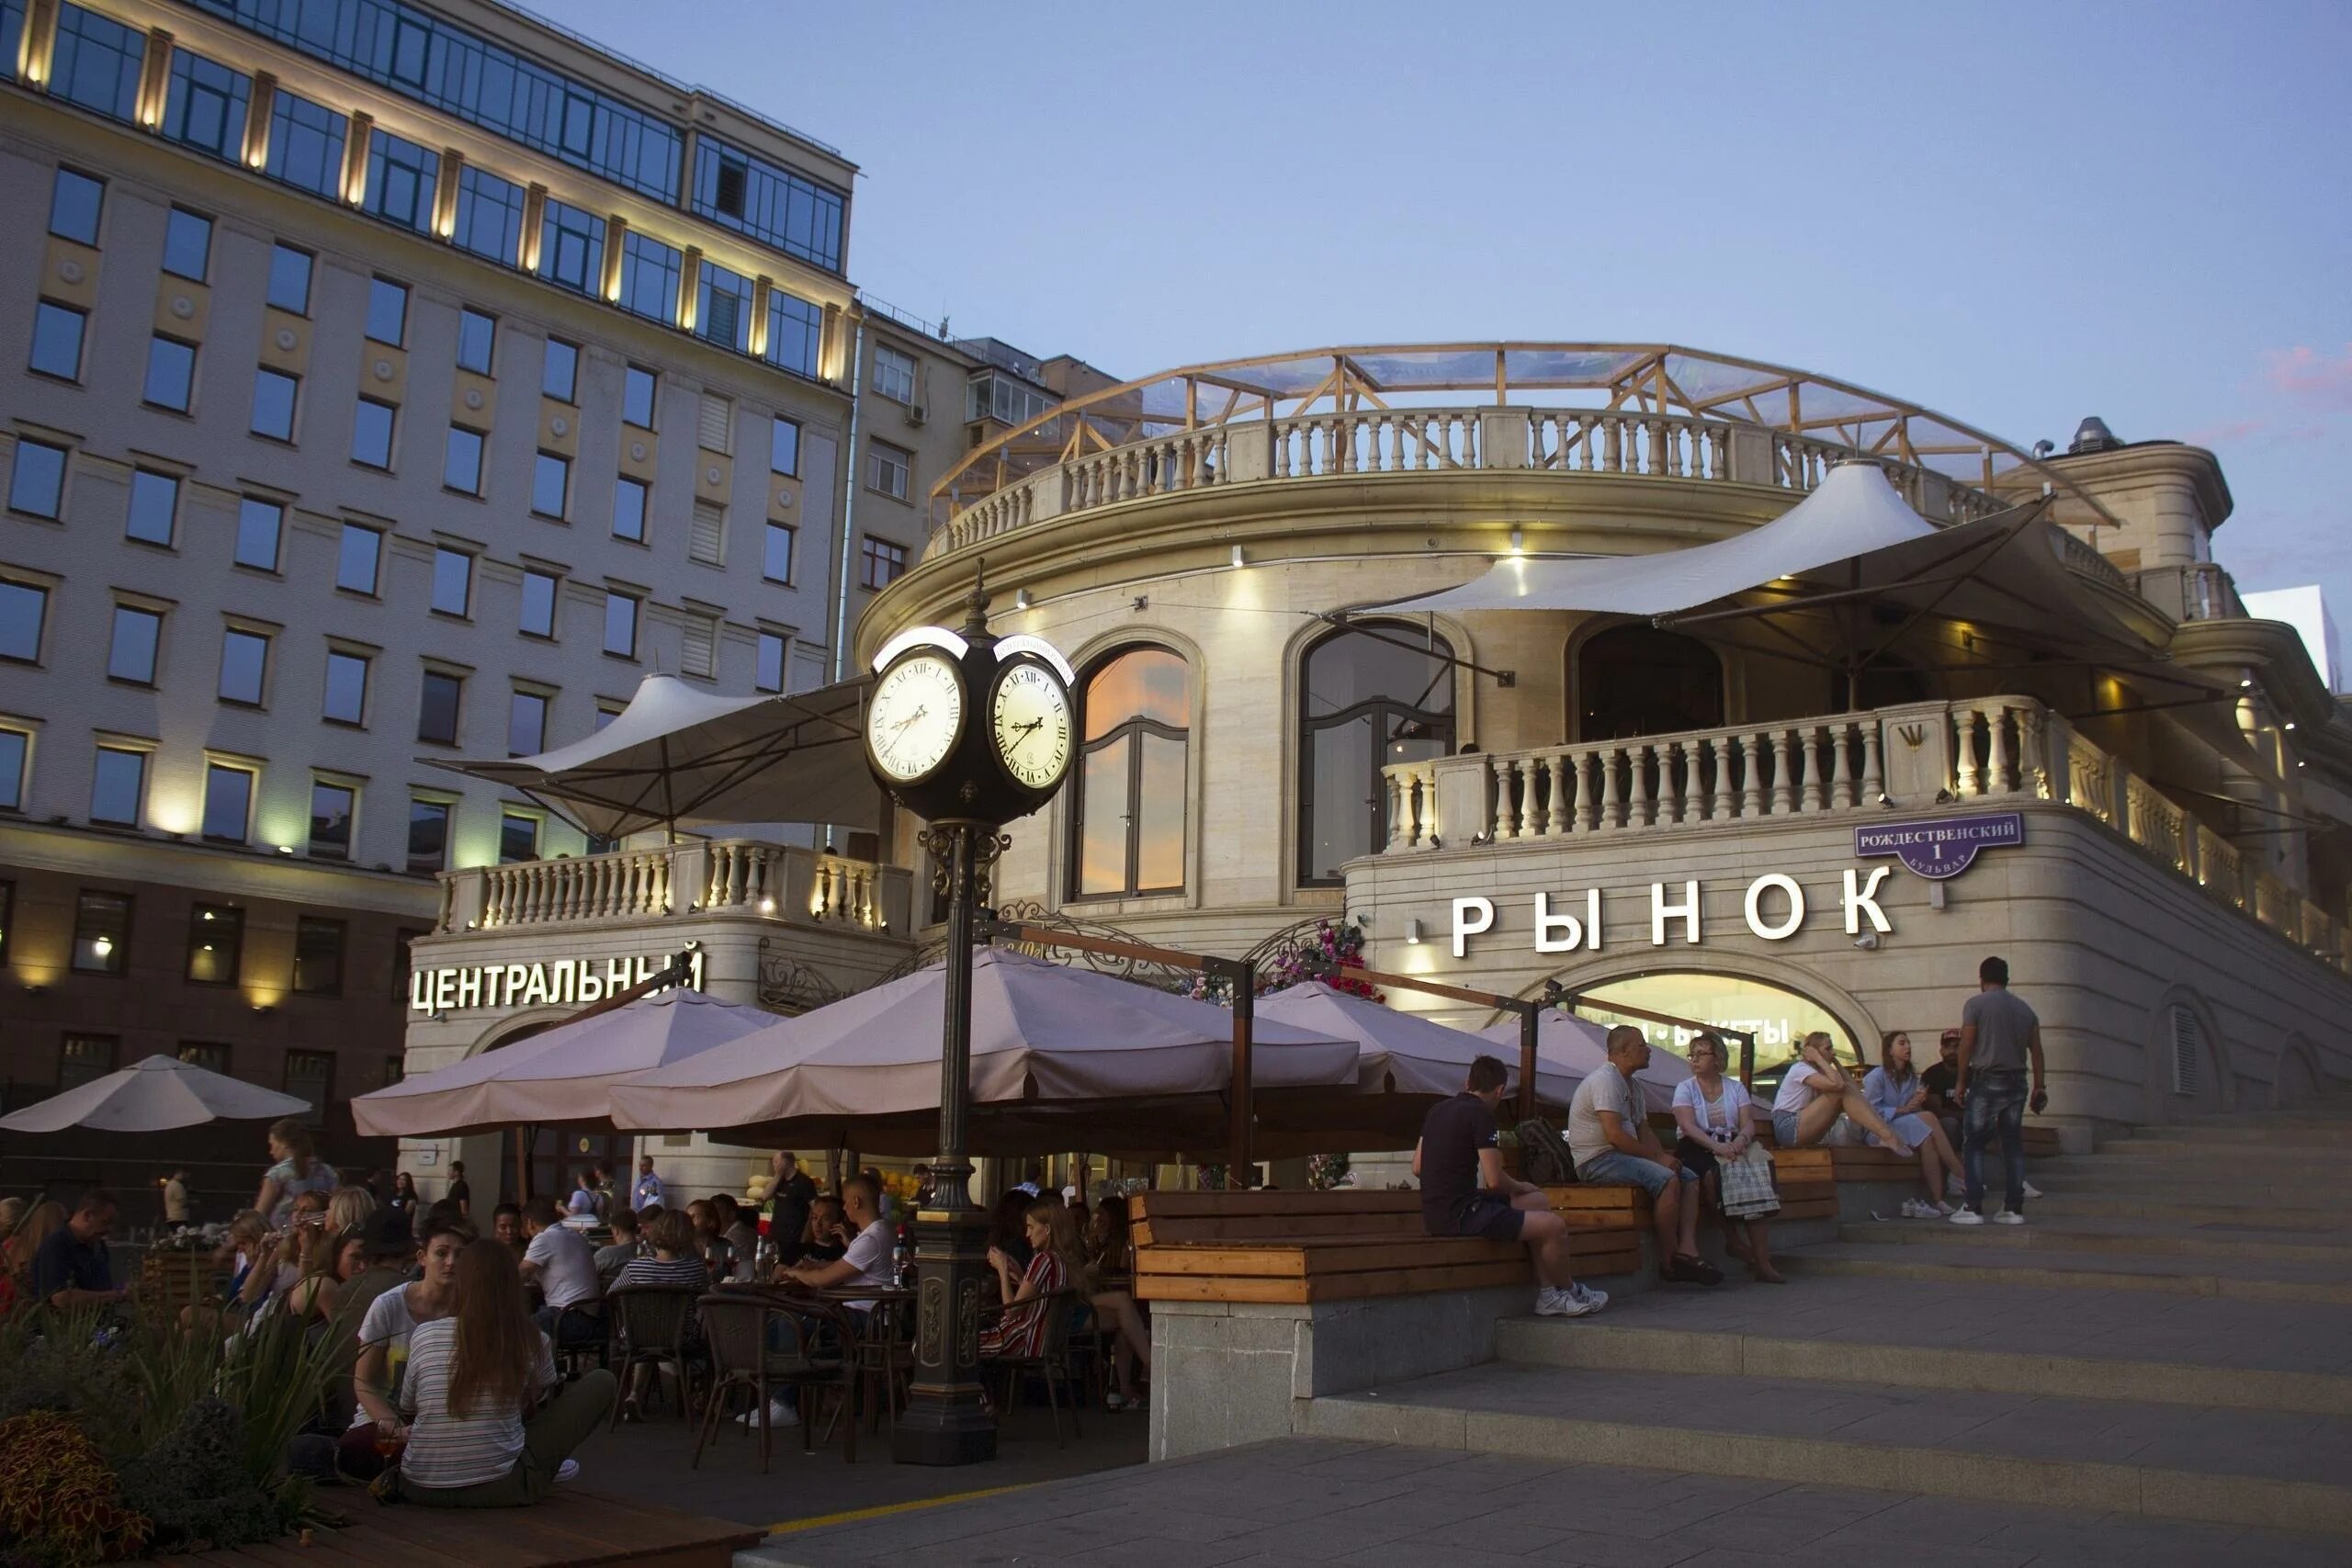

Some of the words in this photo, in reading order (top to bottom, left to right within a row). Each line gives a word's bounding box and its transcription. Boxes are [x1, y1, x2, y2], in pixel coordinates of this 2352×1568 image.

[1860, 821, 2015, 847] РОЖДЕСТВЕНСКИЙ
[1932, 844, 1943, 860] 1
[1909, 854, 1966, 874] БУЛЬВАР
[1453, 865, 1894, 958] РЫНОК
